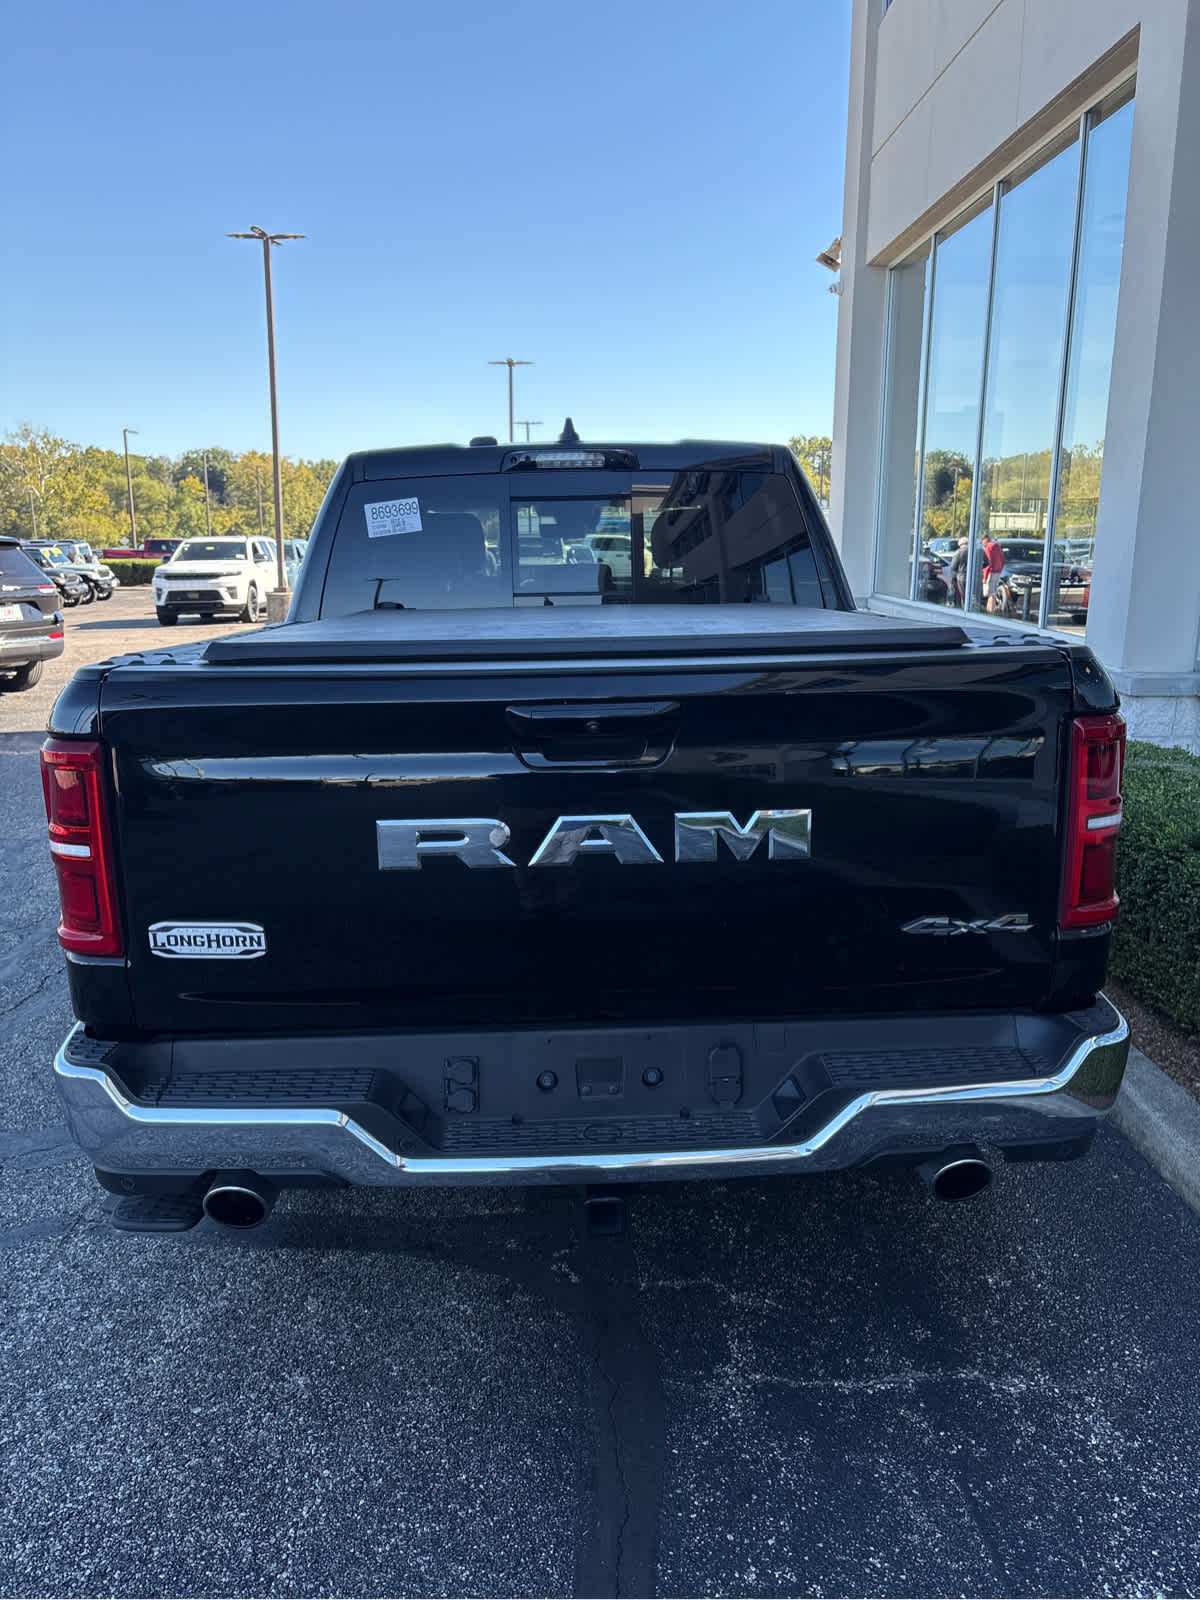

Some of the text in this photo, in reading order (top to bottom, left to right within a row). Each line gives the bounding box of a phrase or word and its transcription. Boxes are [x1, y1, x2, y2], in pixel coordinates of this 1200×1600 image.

[371, 501, 418, 520] 8693699
[376, 809, 812, 870] RAM
[151, 933, 263, 949] LONGHORN
